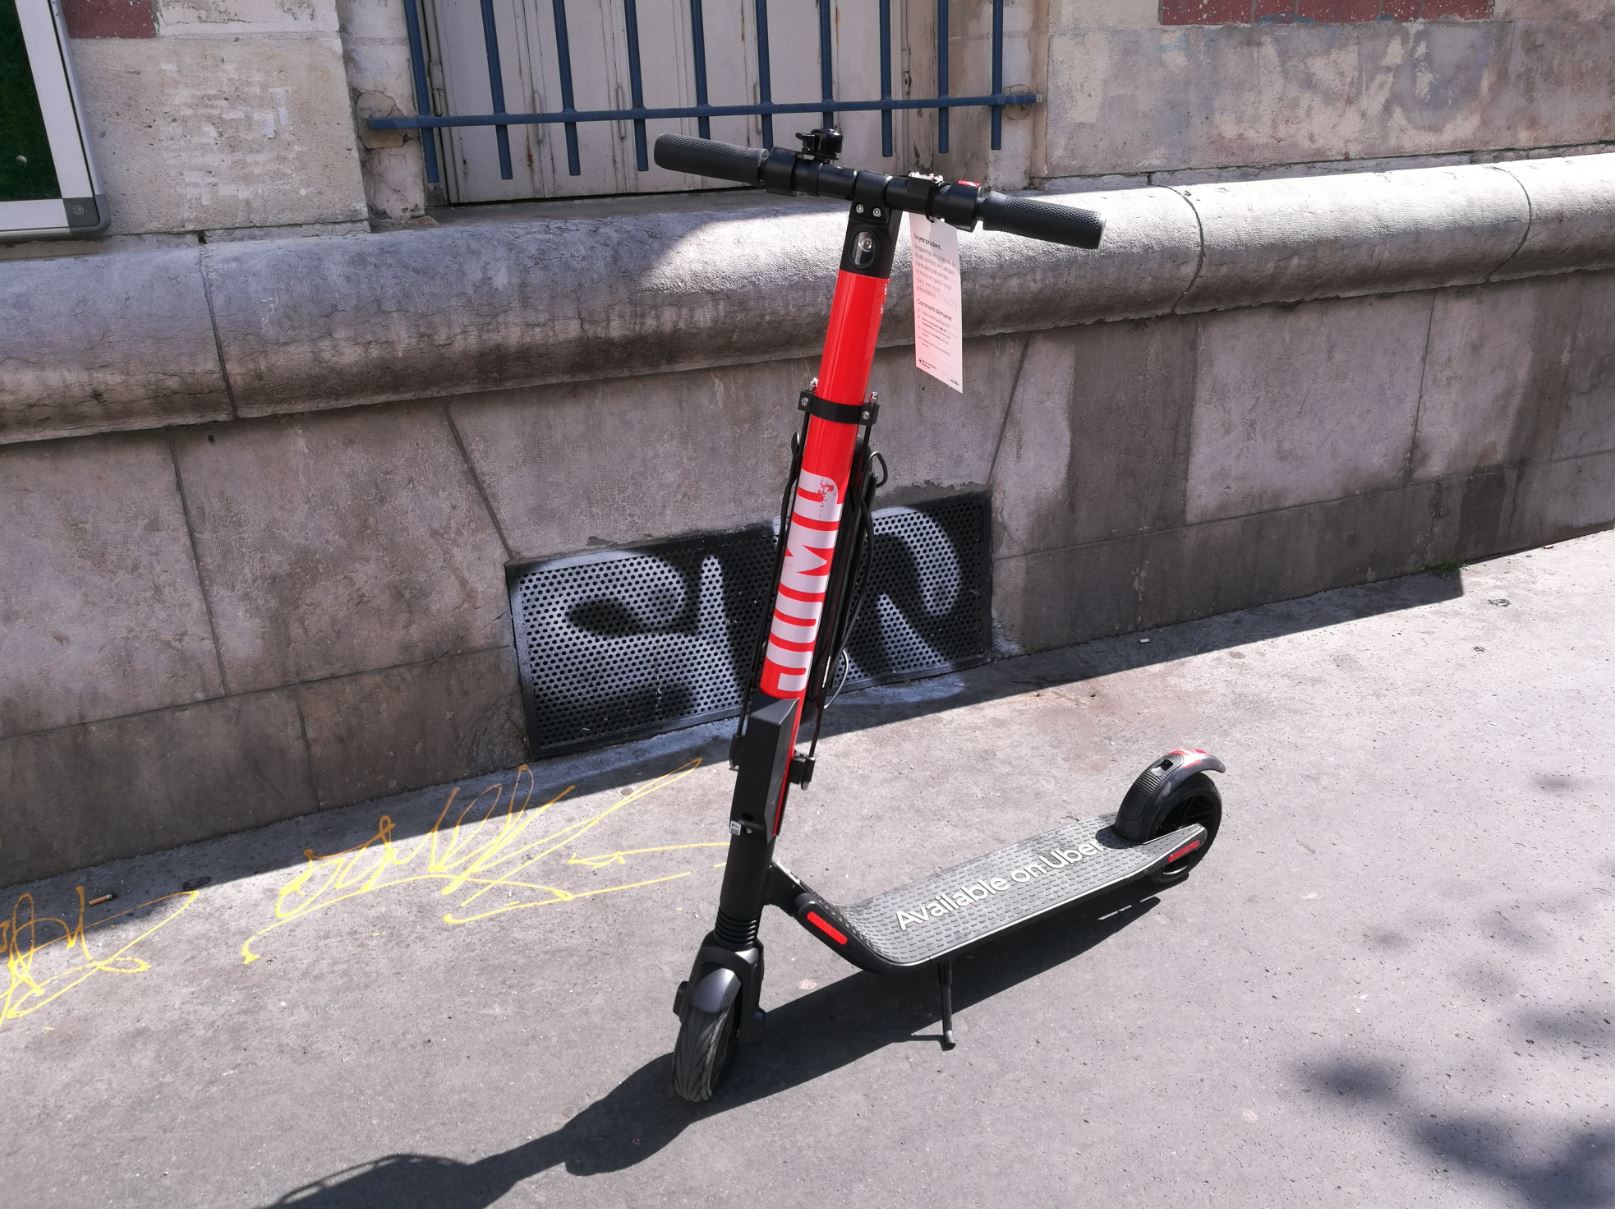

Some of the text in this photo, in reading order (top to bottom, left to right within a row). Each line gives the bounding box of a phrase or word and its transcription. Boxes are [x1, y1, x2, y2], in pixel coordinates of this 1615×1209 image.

[766, 469, 843, 690] JUMP
[896, 839, 1106, 930] Available on Uber
